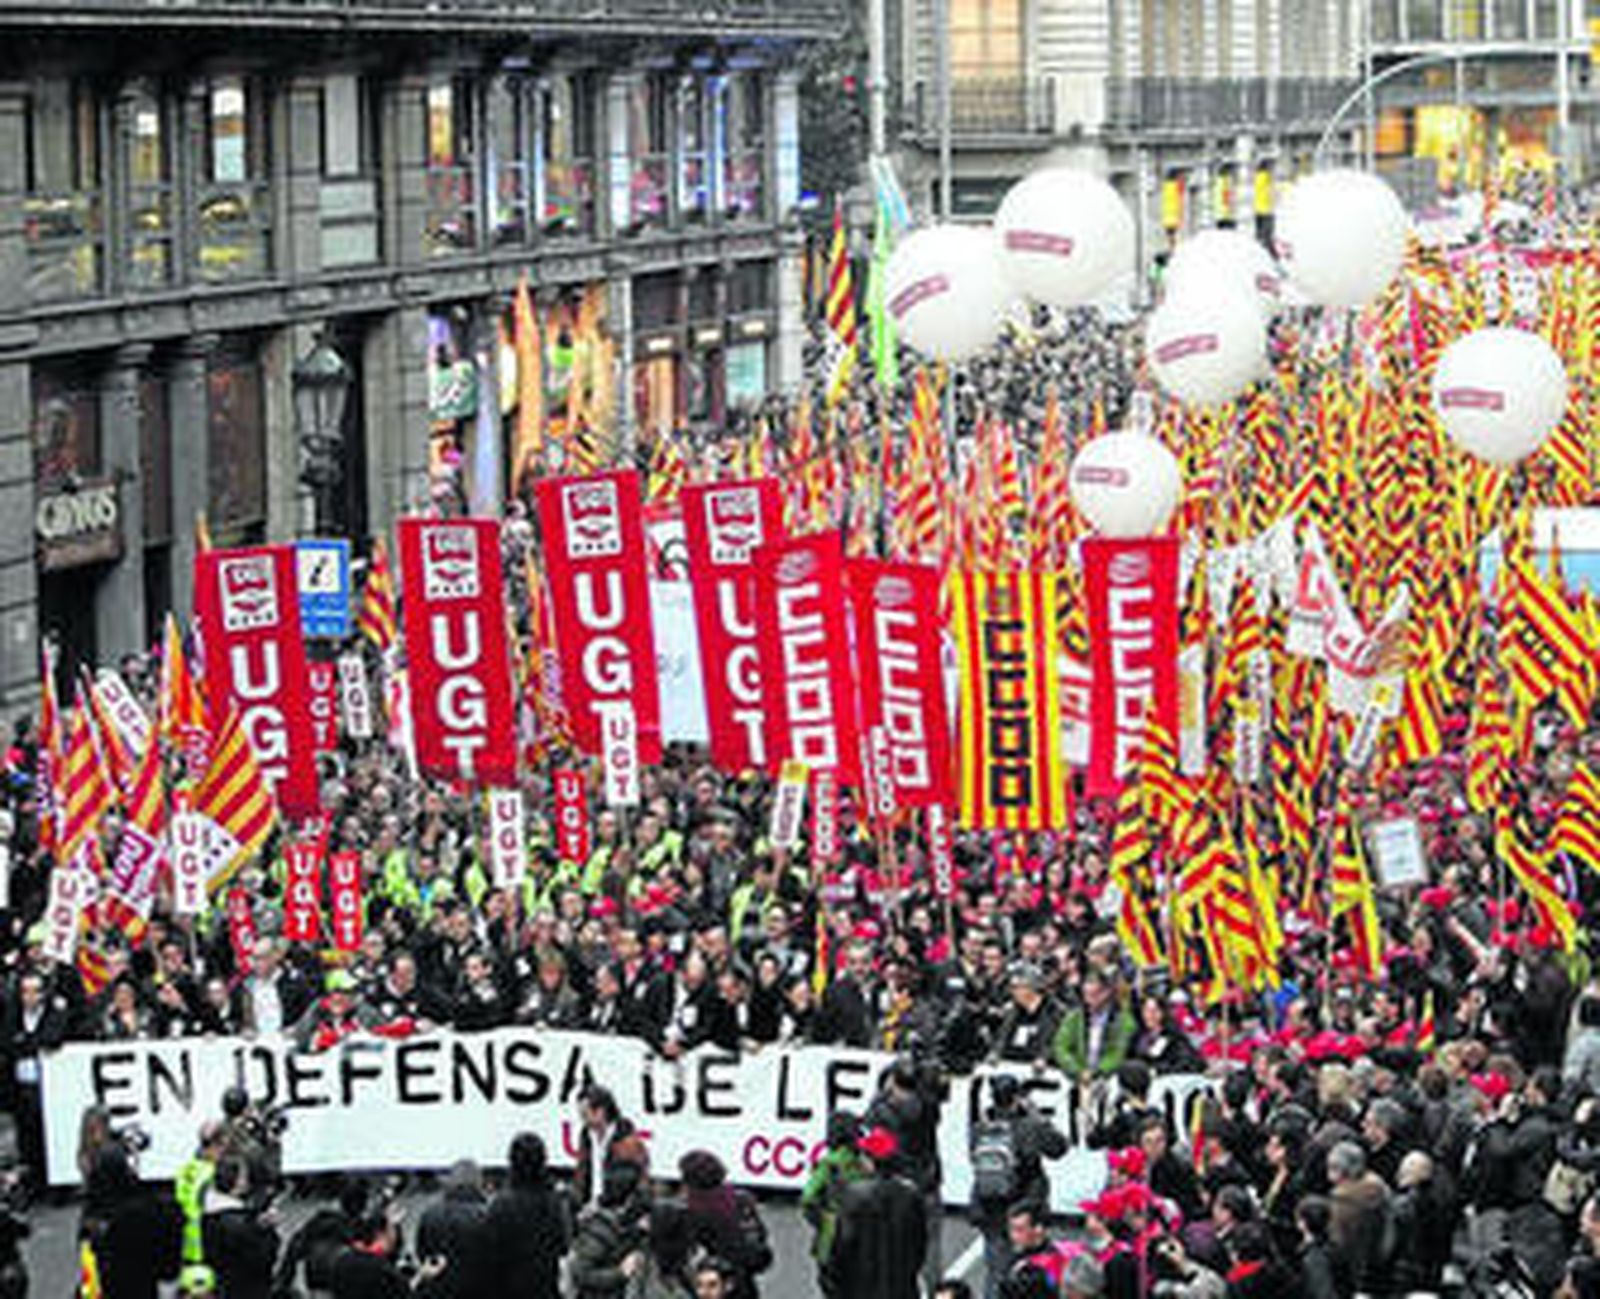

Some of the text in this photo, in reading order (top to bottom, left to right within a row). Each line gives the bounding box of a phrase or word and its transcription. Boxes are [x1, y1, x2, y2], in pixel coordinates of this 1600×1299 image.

[309, 670, 332, 744] UGT
[432, 612, 488, 780] UGT
[776, 582, 838, 768] CCOO
[874, 608, 931, 788] CCOO
[984, 618, 1033, 807] CCOO
[609, 718, 632, 798] UGT
[496, 799, 518, 880] UGT
[559, 777, 582, 857] UGT
[179, 822, 198, 906] UGT
[294, 851, 315, 933] UGT
[335, 859, 357, 944] UGT
[51, 877, 77, 951] UGT
[91, 1049, 194, 1116] EN
